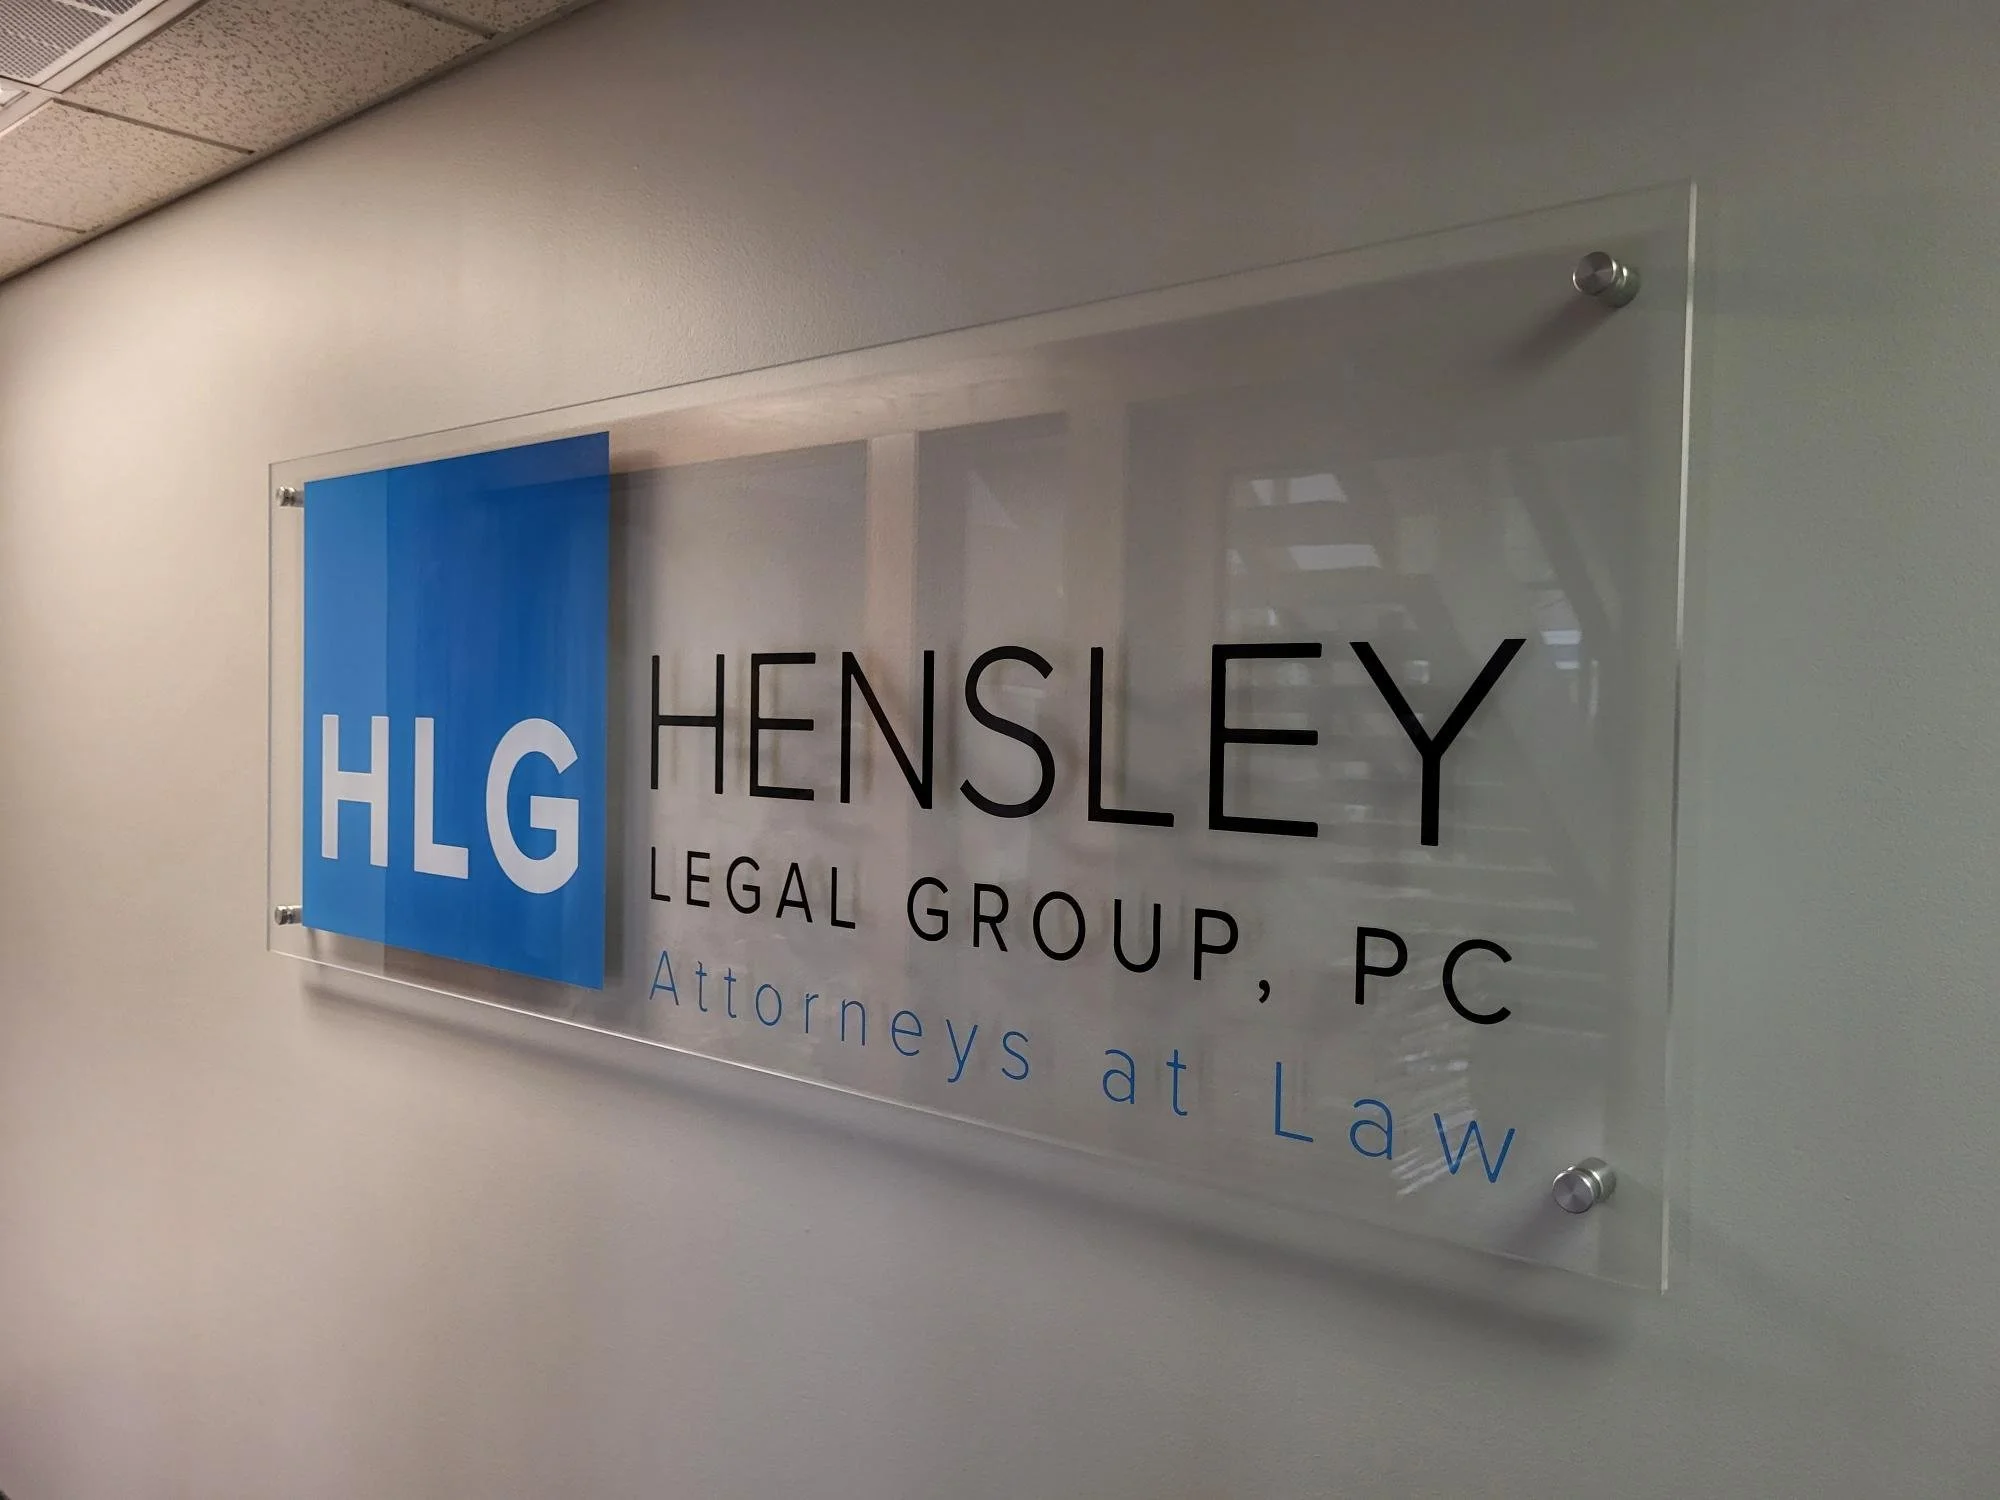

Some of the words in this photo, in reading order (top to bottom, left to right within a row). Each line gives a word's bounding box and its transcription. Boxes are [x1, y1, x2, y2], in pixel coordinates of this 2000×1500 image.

[321, 714, 580, 894] HLG
[650, 638, 1527, 847] HENSLEY
[650, 846, 857, 930] LEGAL
[906, 876, 1273, 1004] GROUP,
[1354, 926, 1513, 1026] PC
[649, 950, 1031, 1084] Attorneys
[1101, 1048, 1188, 1117] at
[1274, 1061, 1516, 1184] Law
